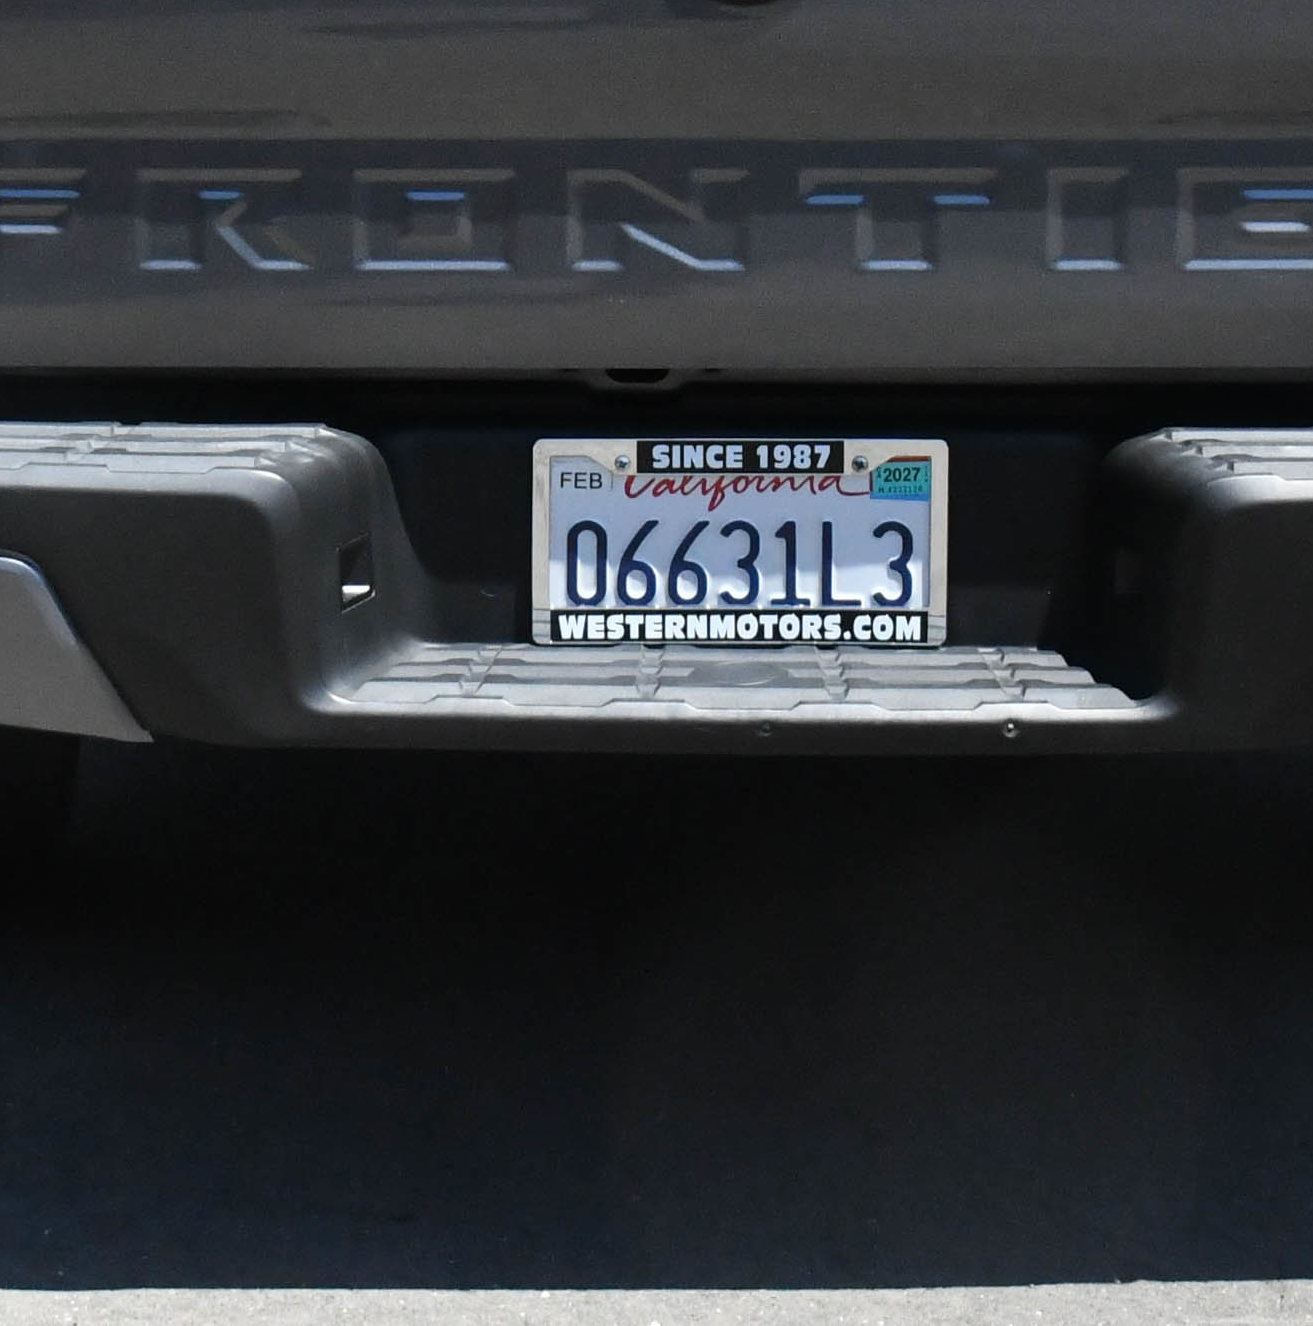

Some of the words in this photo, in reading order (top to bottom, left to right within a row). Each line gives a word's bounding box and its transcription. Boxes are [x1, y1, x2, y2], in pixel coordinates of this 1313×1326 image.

[651, 444, 744, 469] SINCE
[756, 444, 832, 469] 1987
[560, 472, 603, 489] FEB
[883, 467, 921, 482] 2027
[566, 520, 913, 606] 06631L3
[558, 613, 922, 642] WESTERNMOTORS.COM
